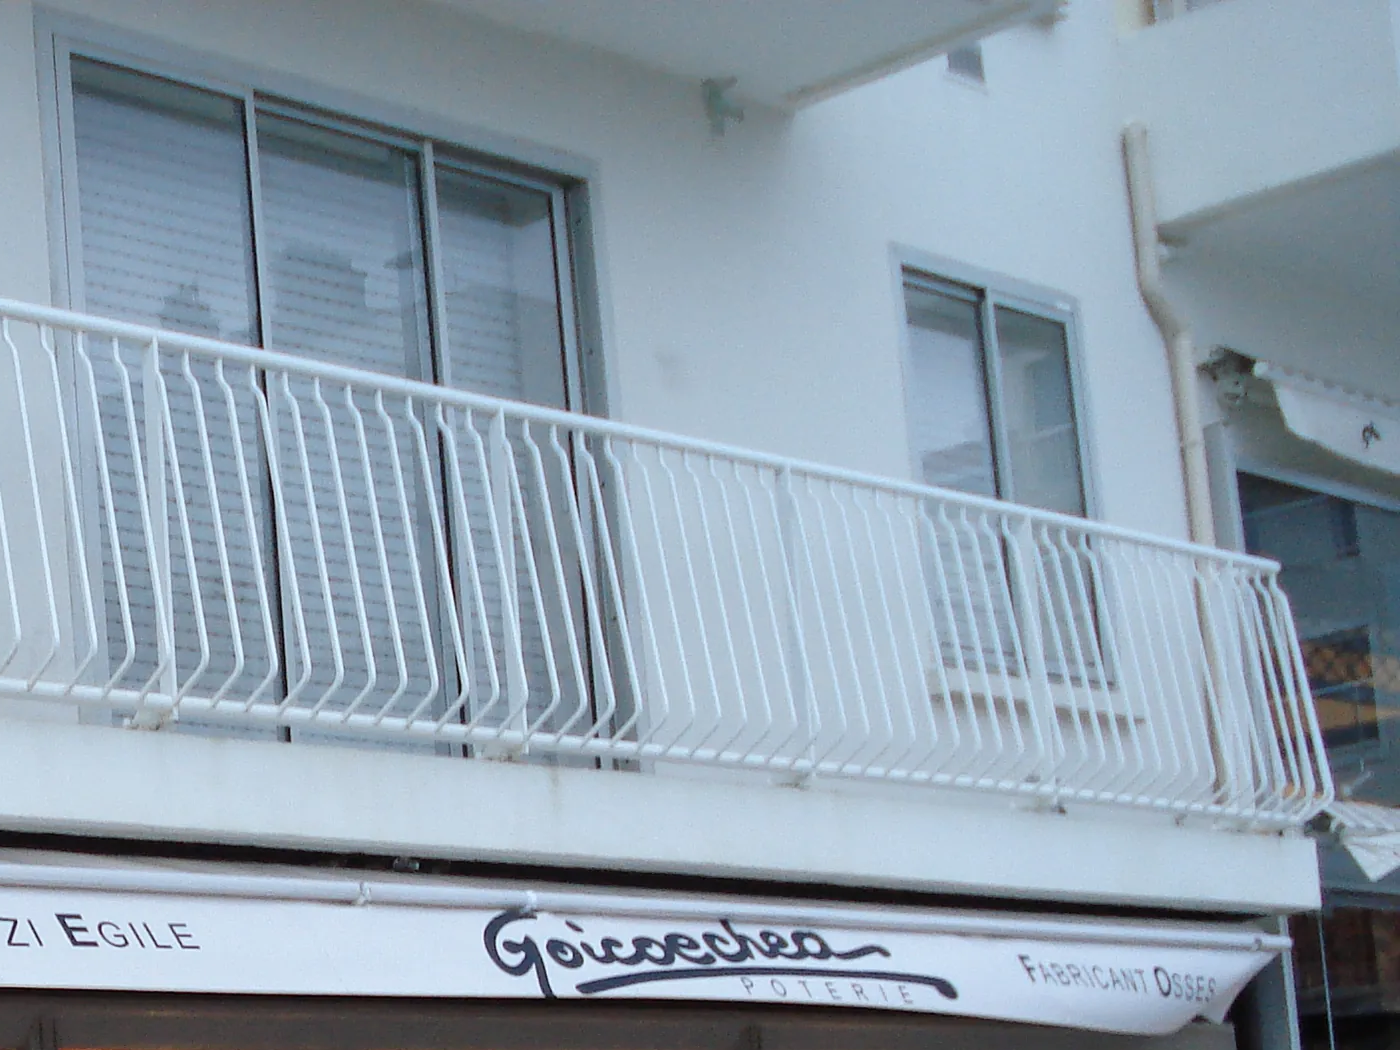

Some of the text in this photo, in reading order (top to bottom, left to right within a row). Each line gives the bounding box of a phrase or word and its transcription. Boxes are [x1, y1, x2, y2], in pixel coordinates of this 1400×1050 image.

[54, 913, 201, 950] EGILE
[483, 907, 891, 999] Goicoechea
[741, 976, 914, 1005] POTERIE
[1017, 953, 1148, 996] FABRICANT
